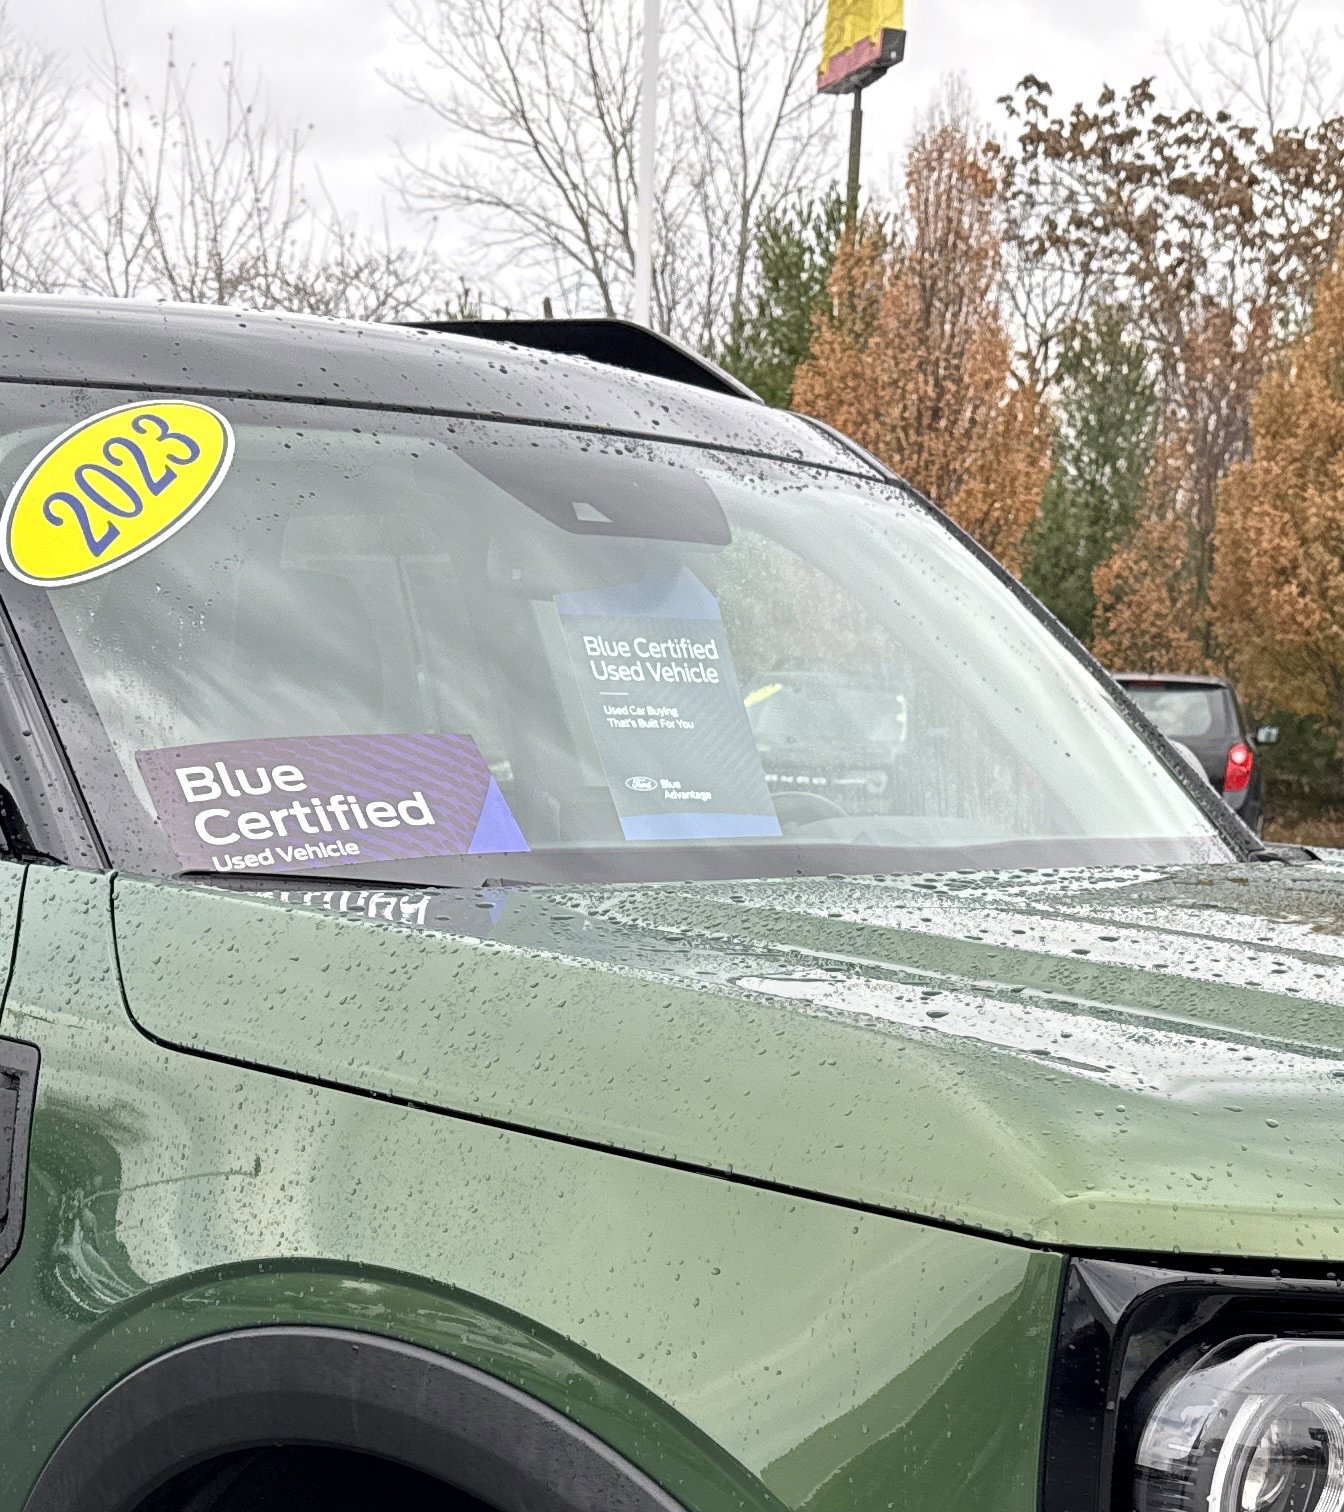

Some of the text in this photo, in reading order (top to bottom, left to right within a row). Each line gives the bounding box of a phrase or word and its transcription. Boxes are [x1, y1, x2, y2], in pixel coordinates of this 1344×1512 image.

[42, 413, 202, 558] 2023
[583, 635, 719, 660] Blue Certified
[589, 660, 720, 684] Used Vehicle
[603, 704, 679, 718] Used Car Buying
[606, 717, 637, 728] That's
[660, 718, 675, 729] For
[676, 719, 695, 729] You
[174, 760, 308, 803] Blue
[194, 791, 436, 847] Certified
[211, 840, 360, 873] Used Vehicle
